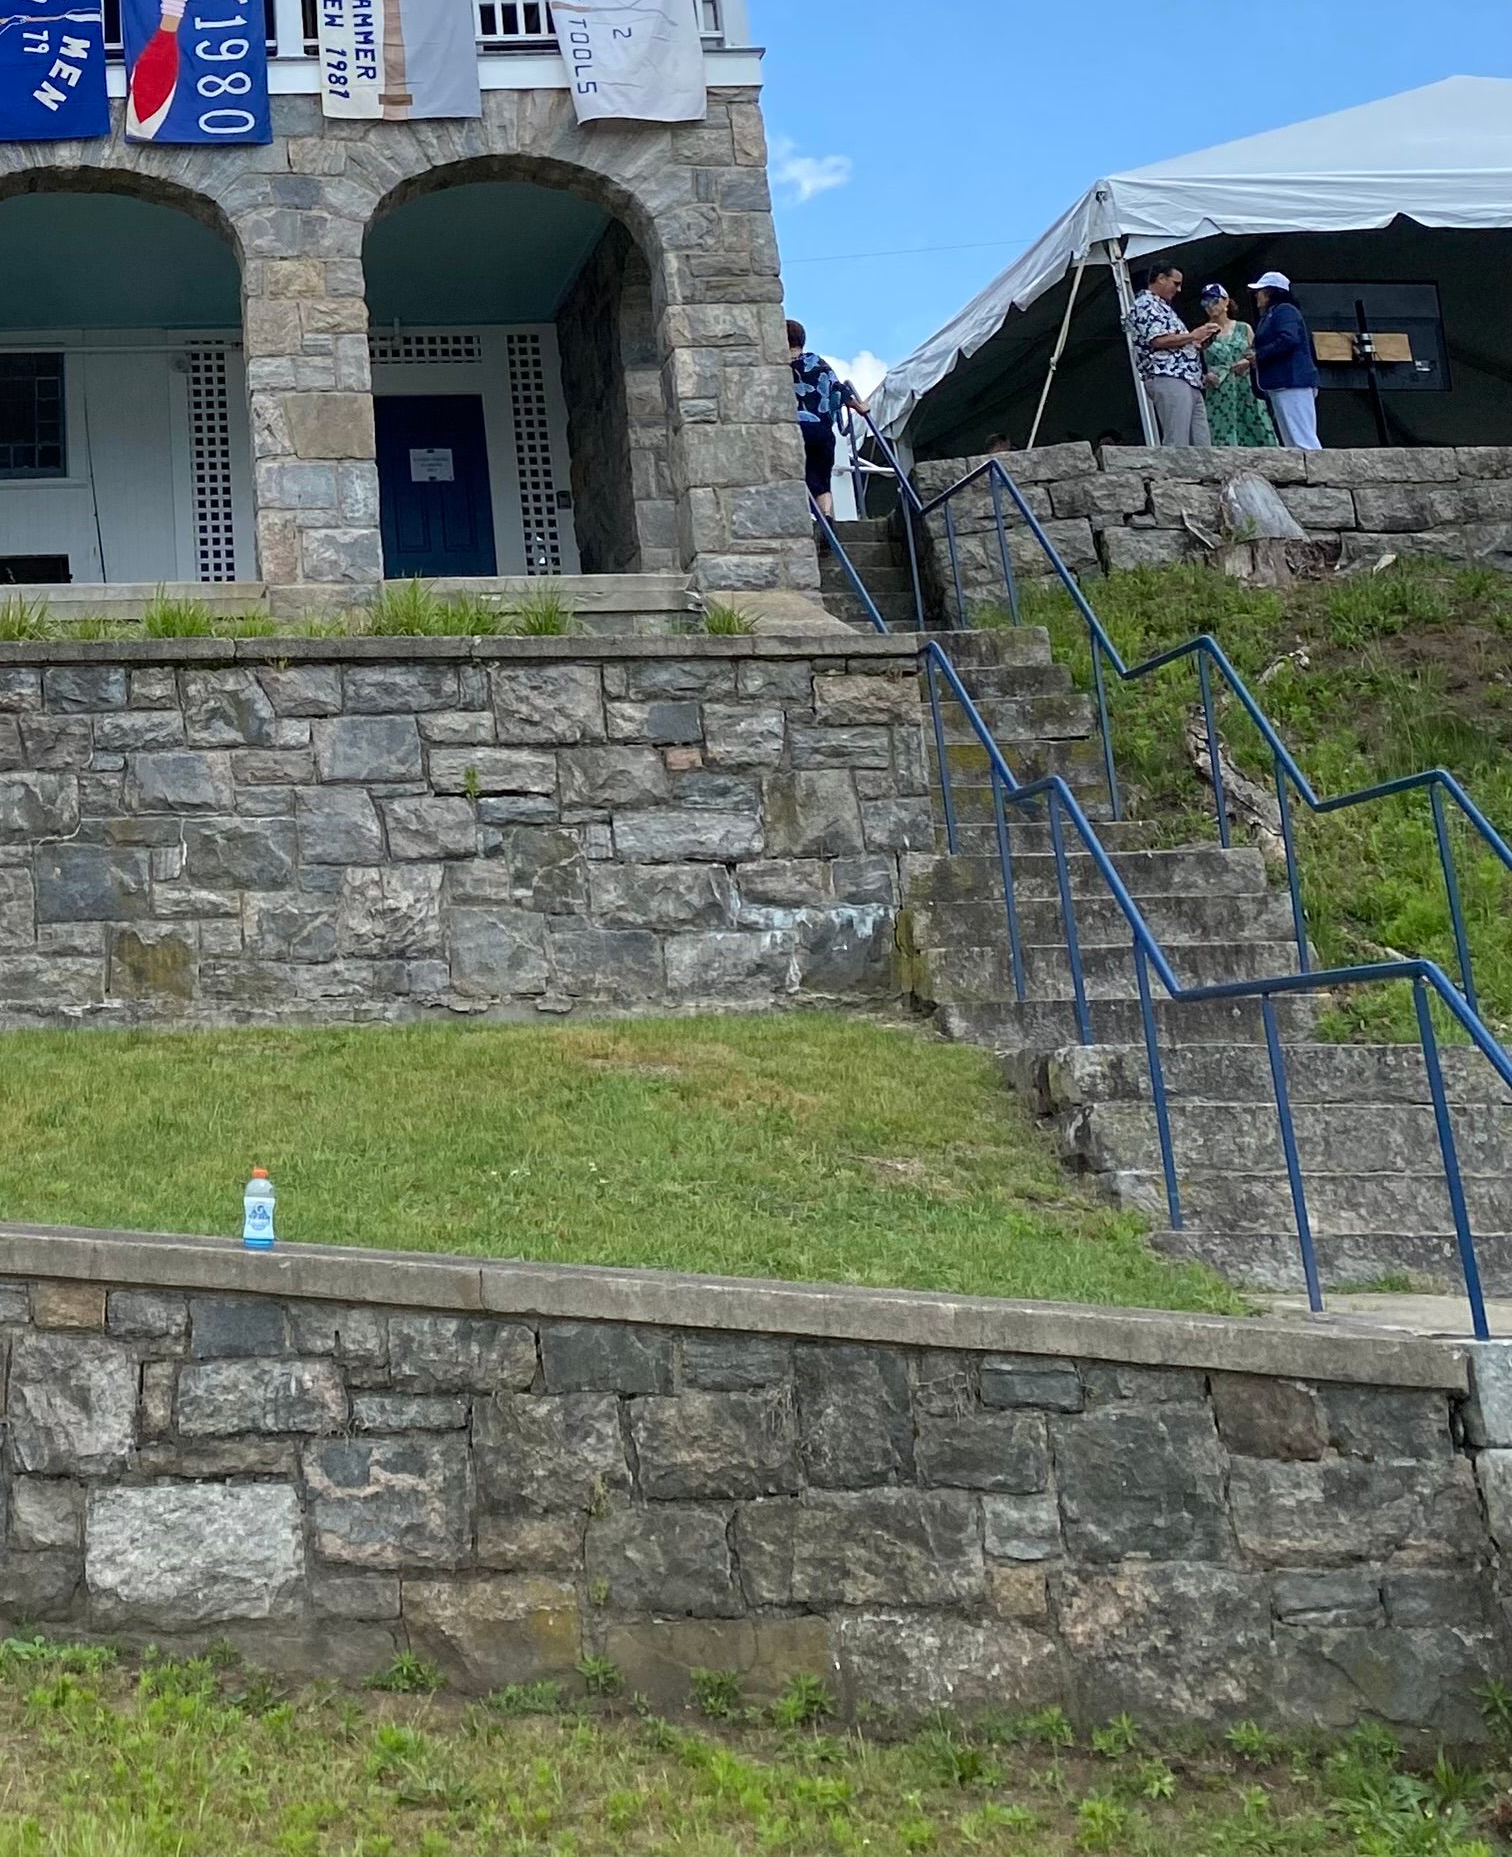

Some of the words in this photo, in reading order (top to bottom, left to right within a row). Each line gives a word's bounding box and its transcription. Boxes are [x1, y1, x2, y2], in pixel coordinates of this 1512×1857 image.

[33, 36, 90, 111] MEN
[194, 15, 256, 135] 1980
[326, 48, 350, 98] 1981
[568, 19, 597, 94] TOOLS
